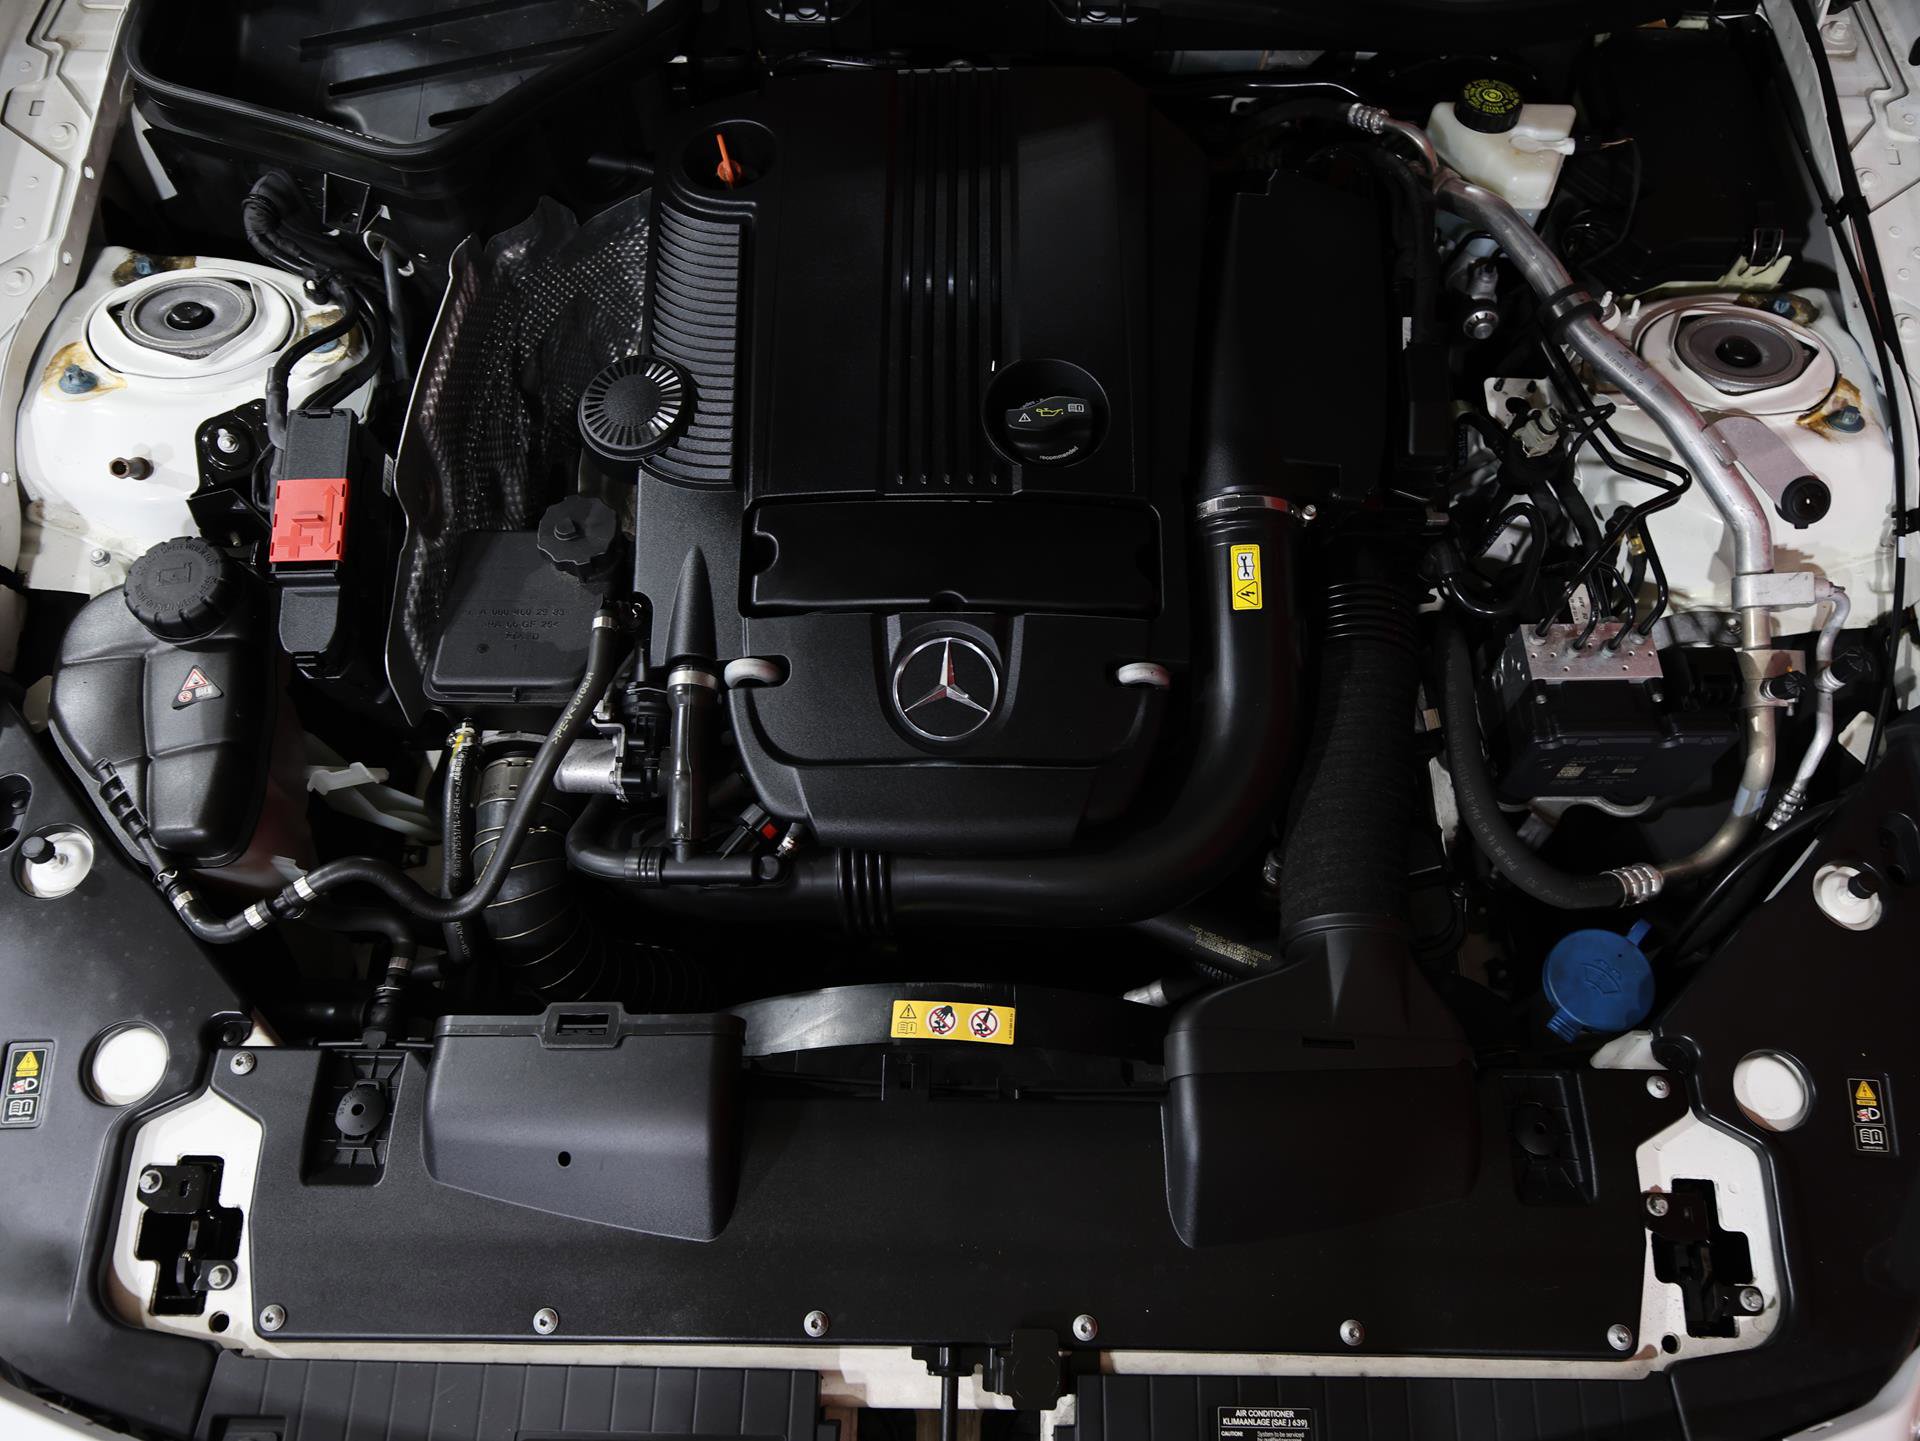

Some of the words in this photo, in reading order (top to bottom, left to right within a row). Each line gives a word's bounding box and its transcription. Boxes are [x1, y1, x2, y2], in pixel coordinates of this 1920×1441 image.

[552, 706, 577, 746] >PE-V<
[1235, 1409, 1247, 1417] AIR
[1248, 1410, 1295, 1418] CONDITIONER
[1222, 1417, 1271, 1426] KLIMAANLAGE
[1271, 1419, 1287, 1428] (SAE
[1292, 1419, 1308, 1428] 639)
